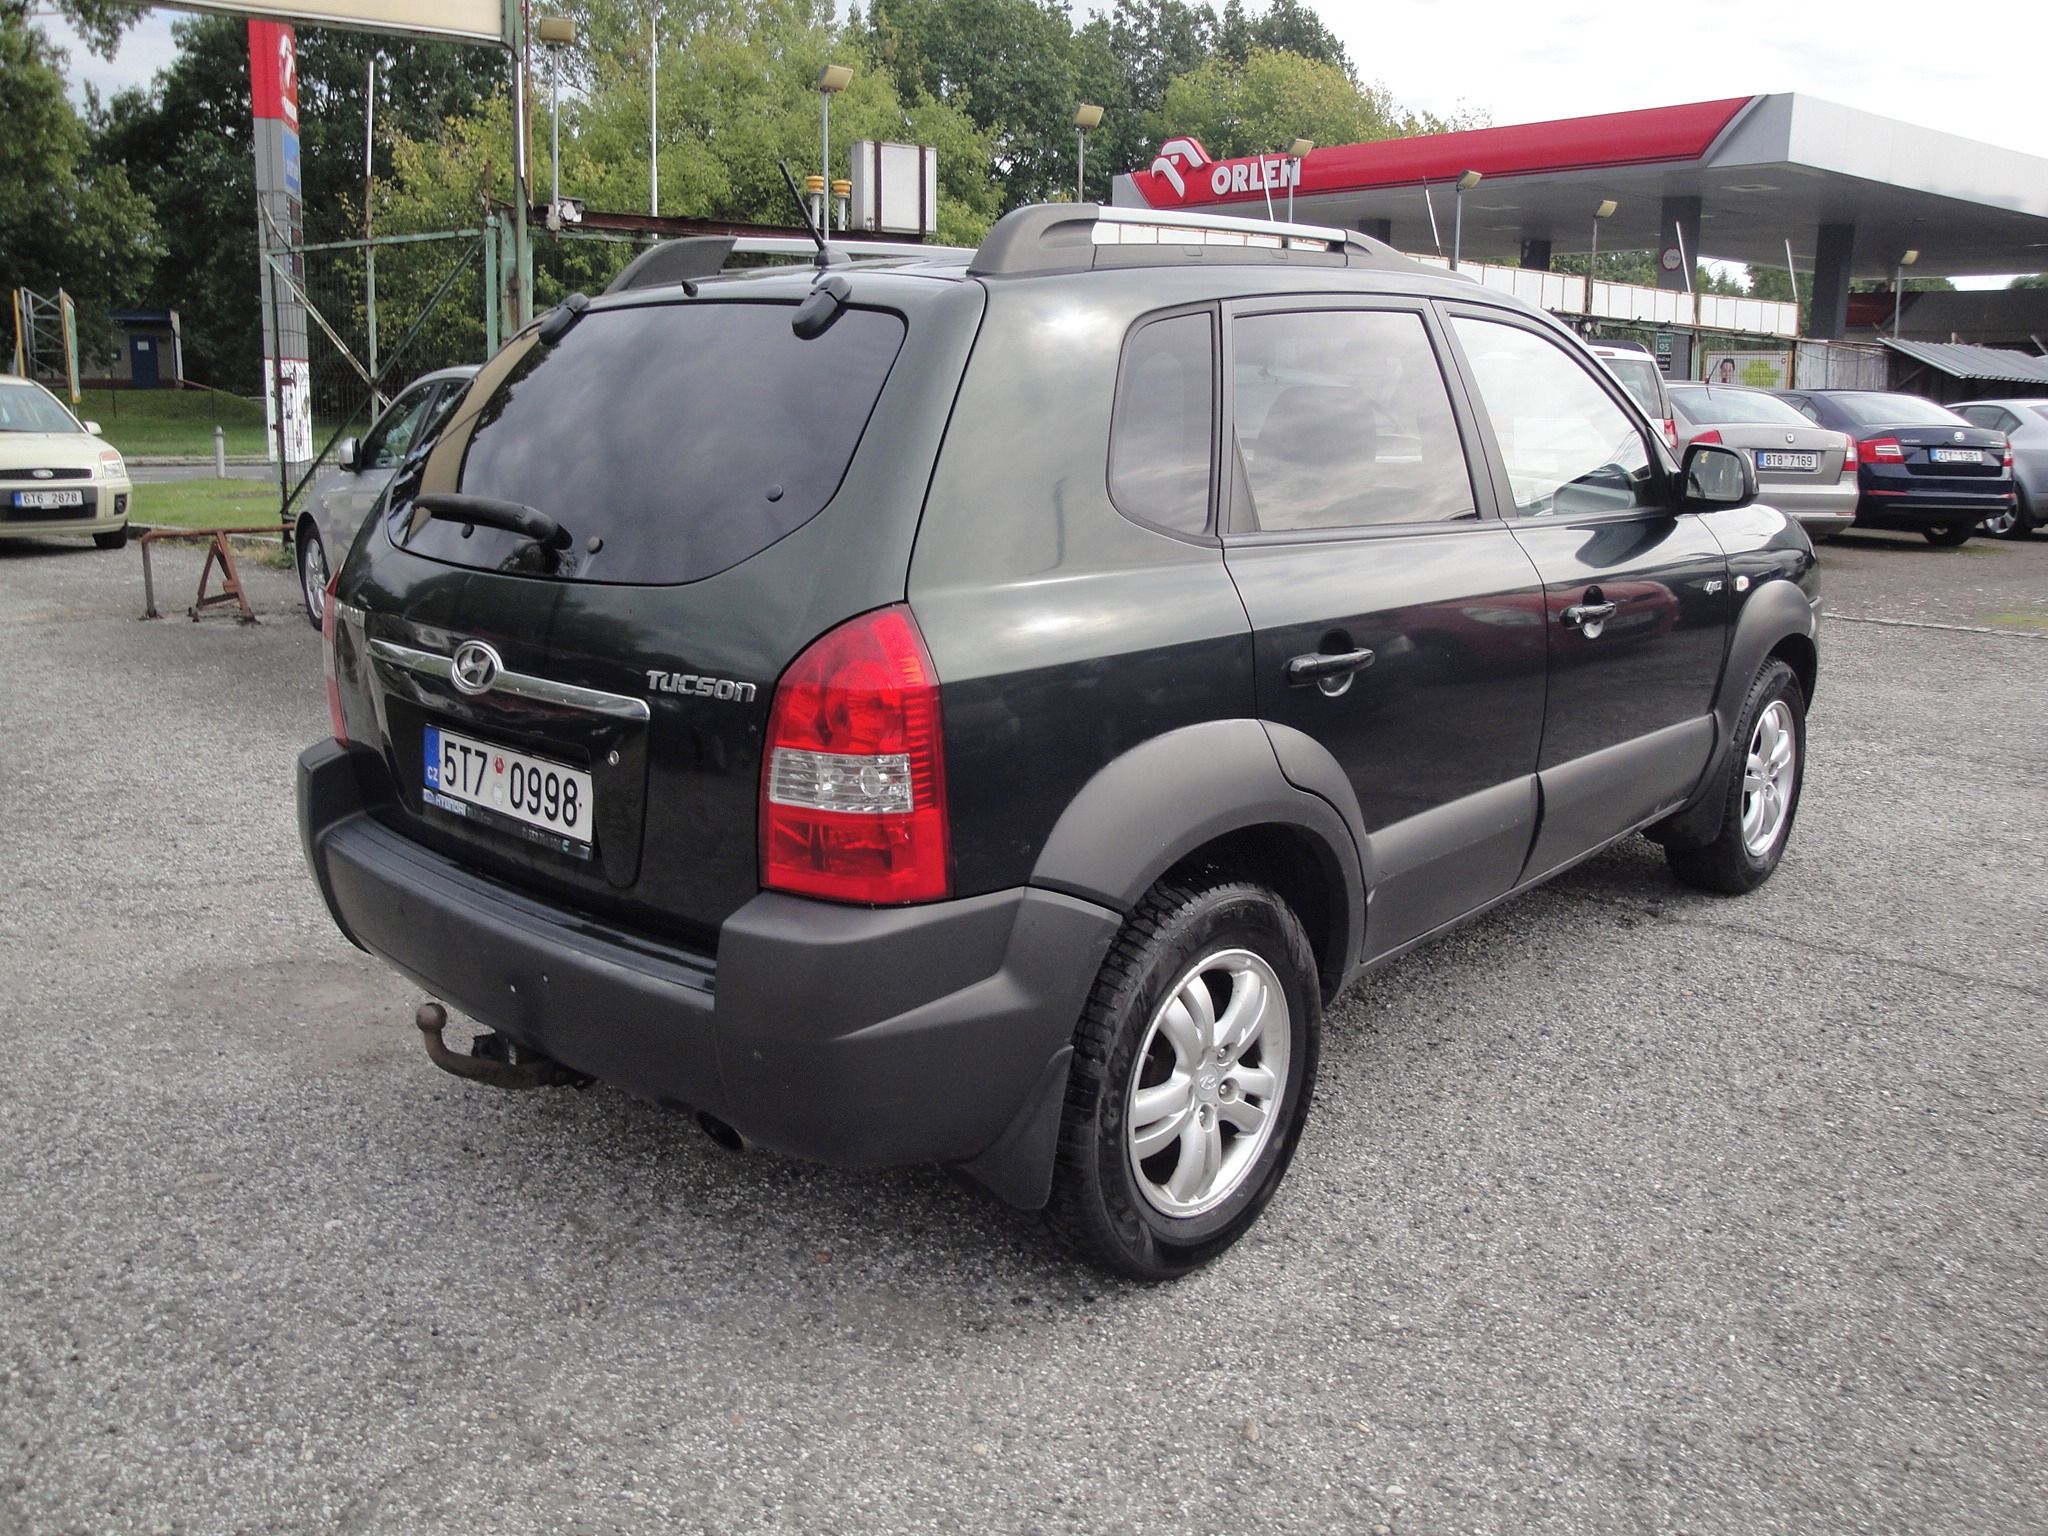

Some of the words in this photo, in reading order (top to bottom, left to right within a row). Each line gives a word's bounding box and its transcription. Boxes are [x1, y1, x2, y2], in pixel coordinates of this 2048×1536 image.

[1211, 158, 1300, 195] ORLEN
[1765, 454, 1783, 466] 8T8
[1789, 455, 1813, 467] 7169
[23, 493, 44, 506] 6T6
[52, 492, 78, 503] 2878
[645, 669, 757, 703] TUCSON
[426, 765, 439, 782] CZ
[443, 739, 488, 797] 5T7
[509, 761, 579, 828] 0998
